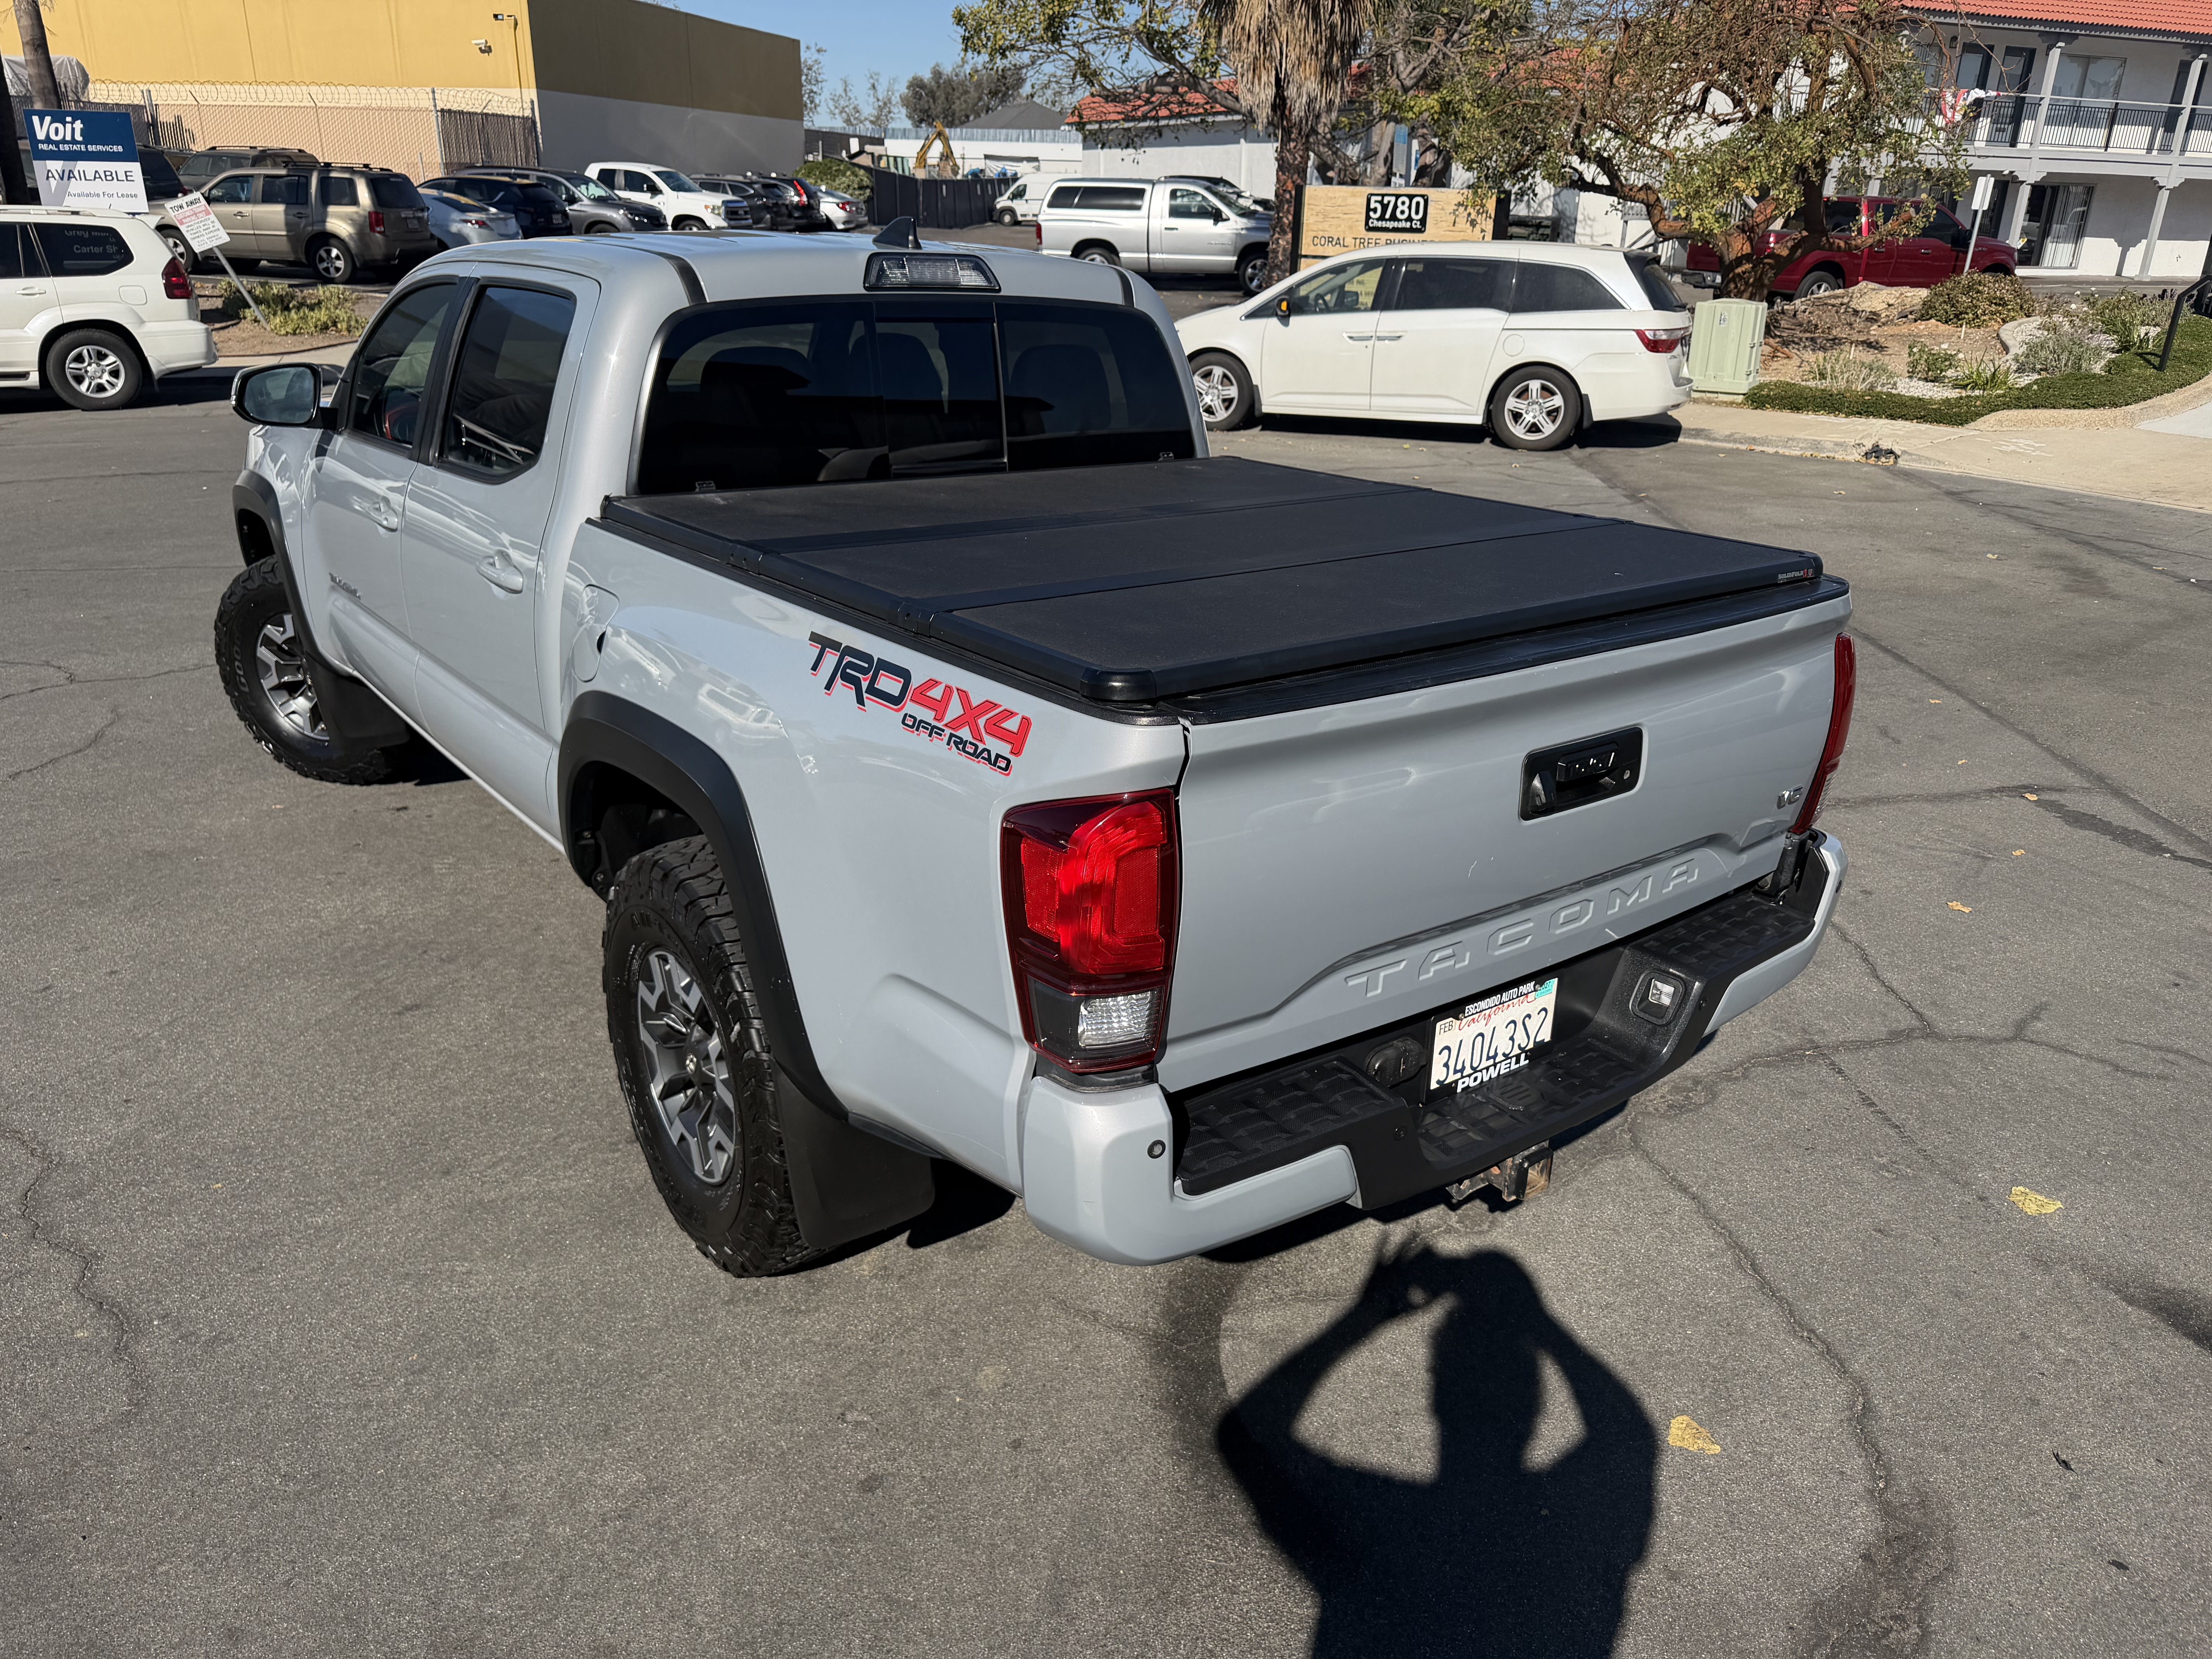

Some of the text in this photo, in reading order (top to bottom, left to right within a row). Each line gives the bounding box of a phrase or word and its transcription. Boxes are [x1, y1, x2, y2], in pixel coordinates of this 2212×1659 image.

[32, 115, 83, 141] Voit
[46, 169, 135, 182] AVAILABLE
[170, 197, 202, 213] TOW AWAY
[1369, 196, 1424, 220] 5780
[1369, 219, 1422, 229] Chesapeake Ct.
[74, 245, 103, 253] Carter
[1312, 236, 1349, 248] CORAL
[1352, 237, 1381, 248] TREE
[809, 631, 913, 713] TRD
[901, 713, 1013, 777] OFF ROAD
[1345, 859, 1699, 997] TACOMA
[1465, 995, 1501, 1017] ESCONDIDO
[1501, 988, 1518, 1004] AUTO
[1518, 981, 1535, 999] PARK
[1458, 994, 1537, 1031] California
[1439, 1020, 1453, 1035] FEB
[1436, 1007, 1548, 1086] 34043S2
[1457, 1053, 1529, 1093] POWELL
